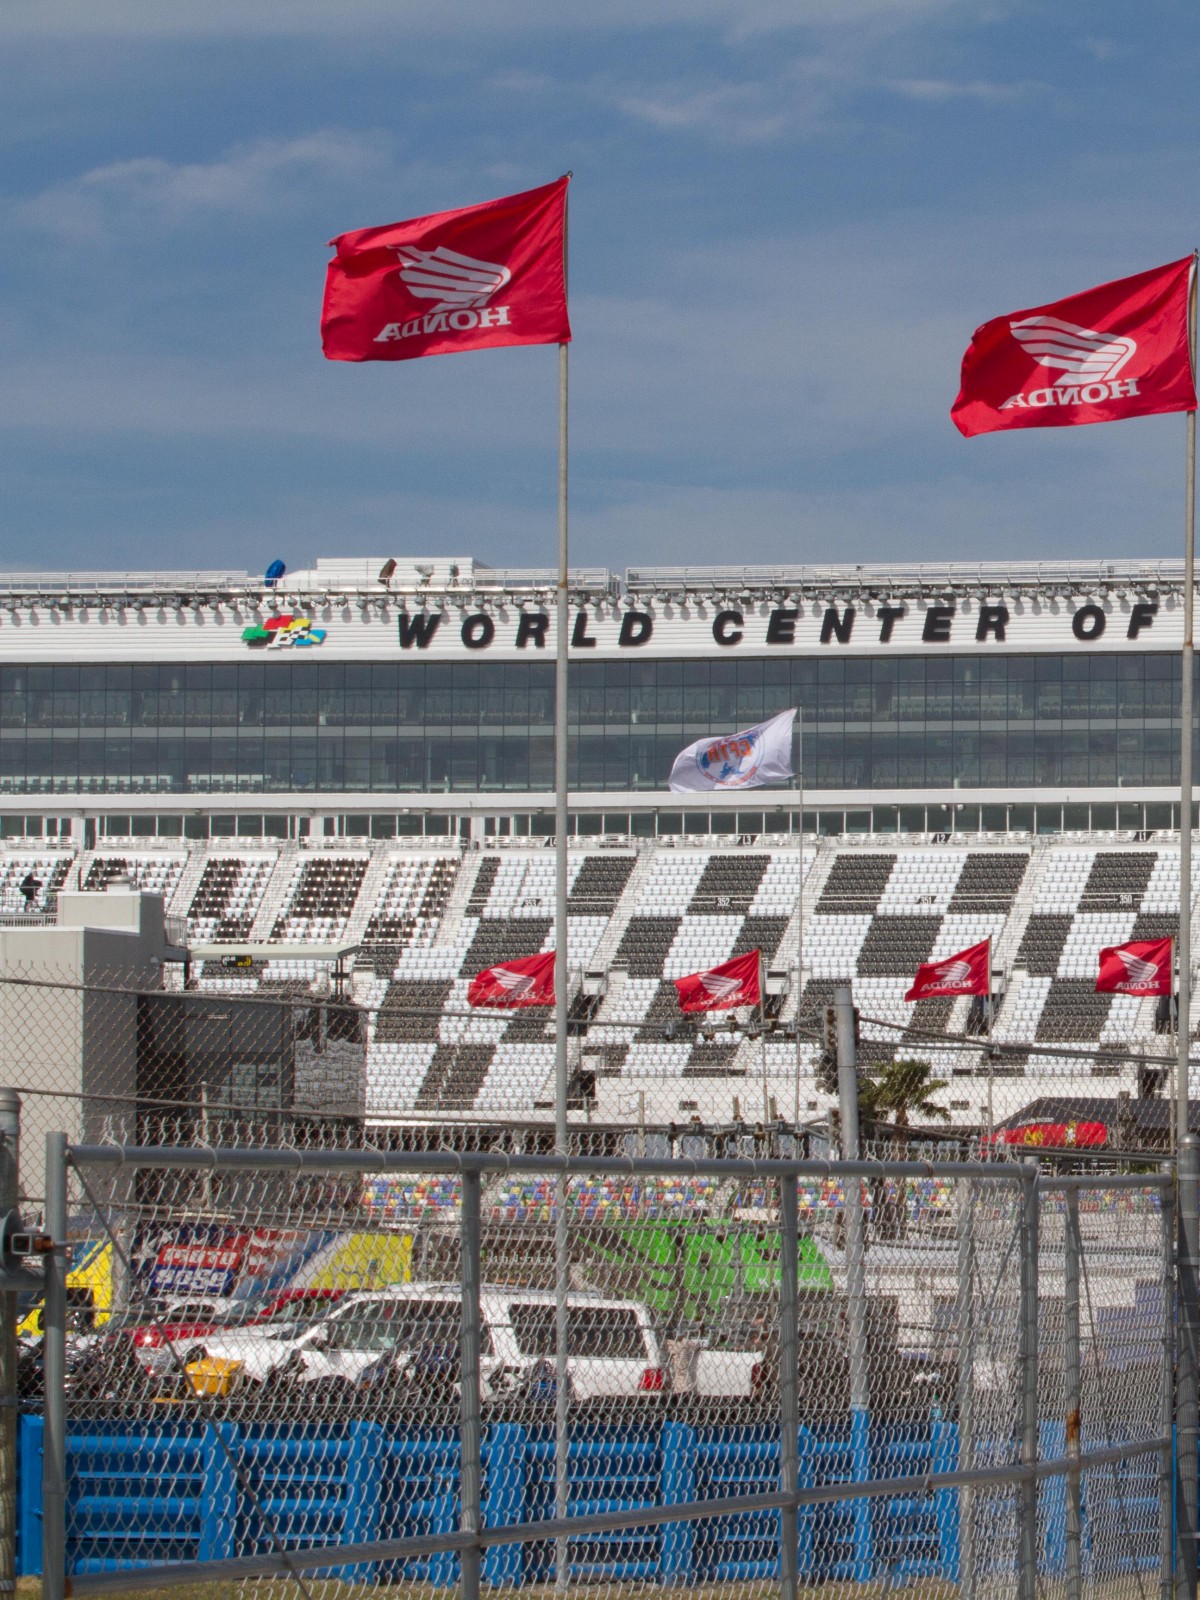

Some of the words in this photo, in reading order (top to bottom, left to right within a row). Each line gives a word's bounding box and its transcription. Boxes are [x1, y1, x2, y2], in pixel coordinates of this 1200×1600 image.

[398, 611, 654, 649] WORLD
[712, 606, 1009, 646] CENTER
[1072, 604, 1158, 641] OF
[717, 897, 731, 907] 352
